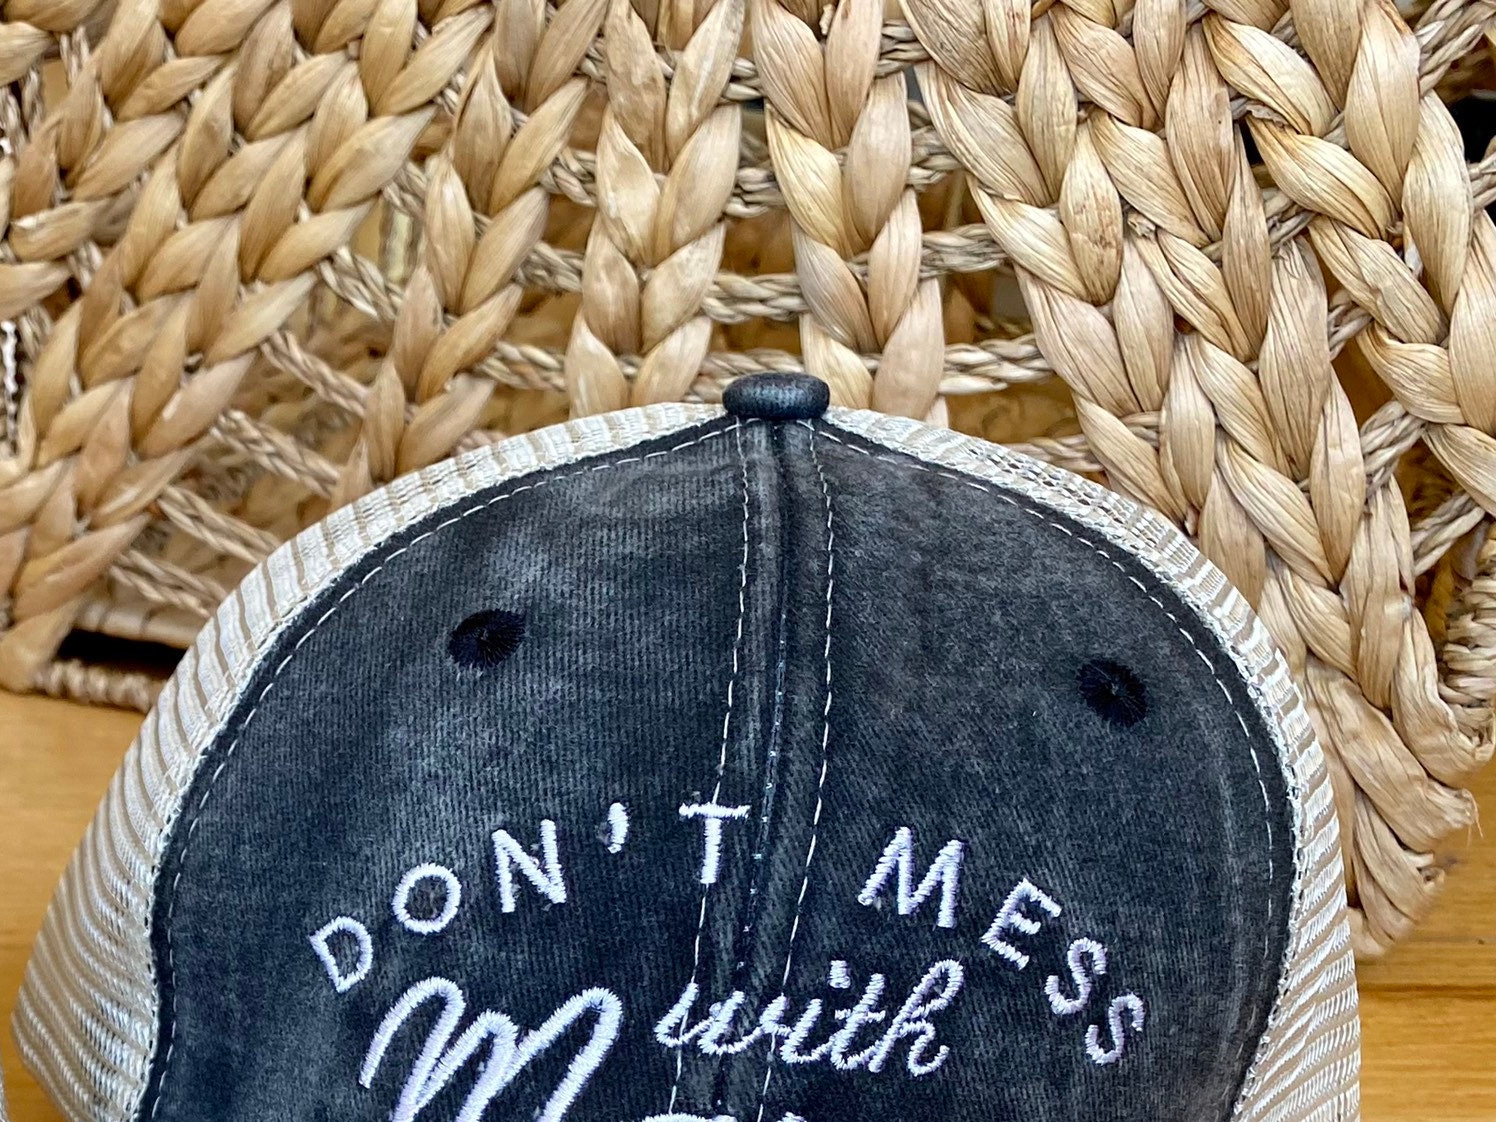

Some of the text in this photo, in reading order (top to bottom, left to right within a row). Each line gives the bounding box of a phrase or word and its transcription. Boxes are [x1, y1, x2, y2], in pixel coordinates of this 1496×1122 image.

[310, 802, 1145, 1066] DON'T MESS
[653, 958, 965, 1077] with
